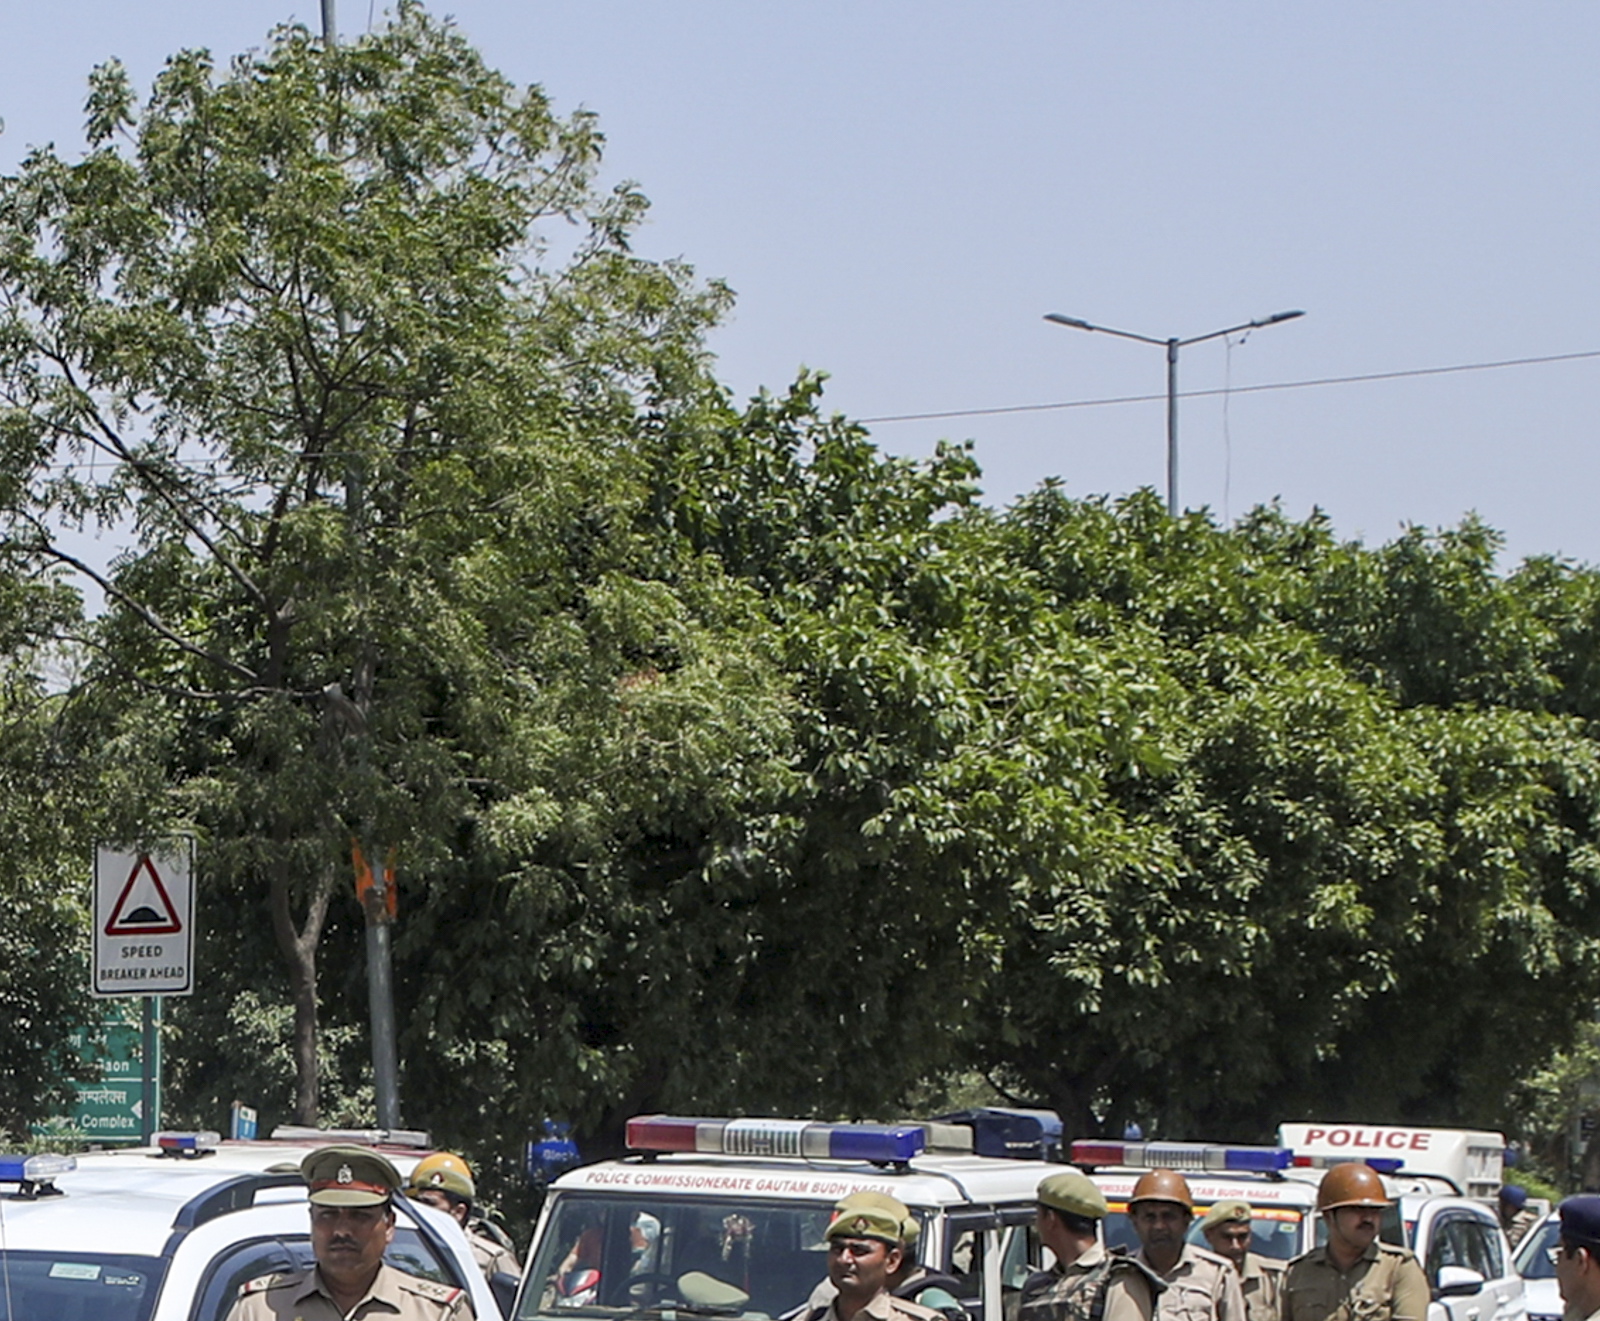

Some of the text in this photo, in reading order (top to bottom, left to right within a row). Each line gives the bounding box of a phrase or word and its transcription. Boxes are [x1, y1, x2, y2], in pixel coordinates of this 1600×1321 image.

[121, 945, 163, 959] SPEED
[100, 966, 185, 981] BREAKER AHEAD
[81, 1114, 135, 1129] Complex
[1303, 1129, 1432, 1151] POLICE
[586, 1172, 632, 1185] POLICE
[634, 1172, 753, 1191] COMMISSIONERATE
[756, 1178, 808, 1193] GAUTAM
[811, 1181, 848, 1195] BUDH
